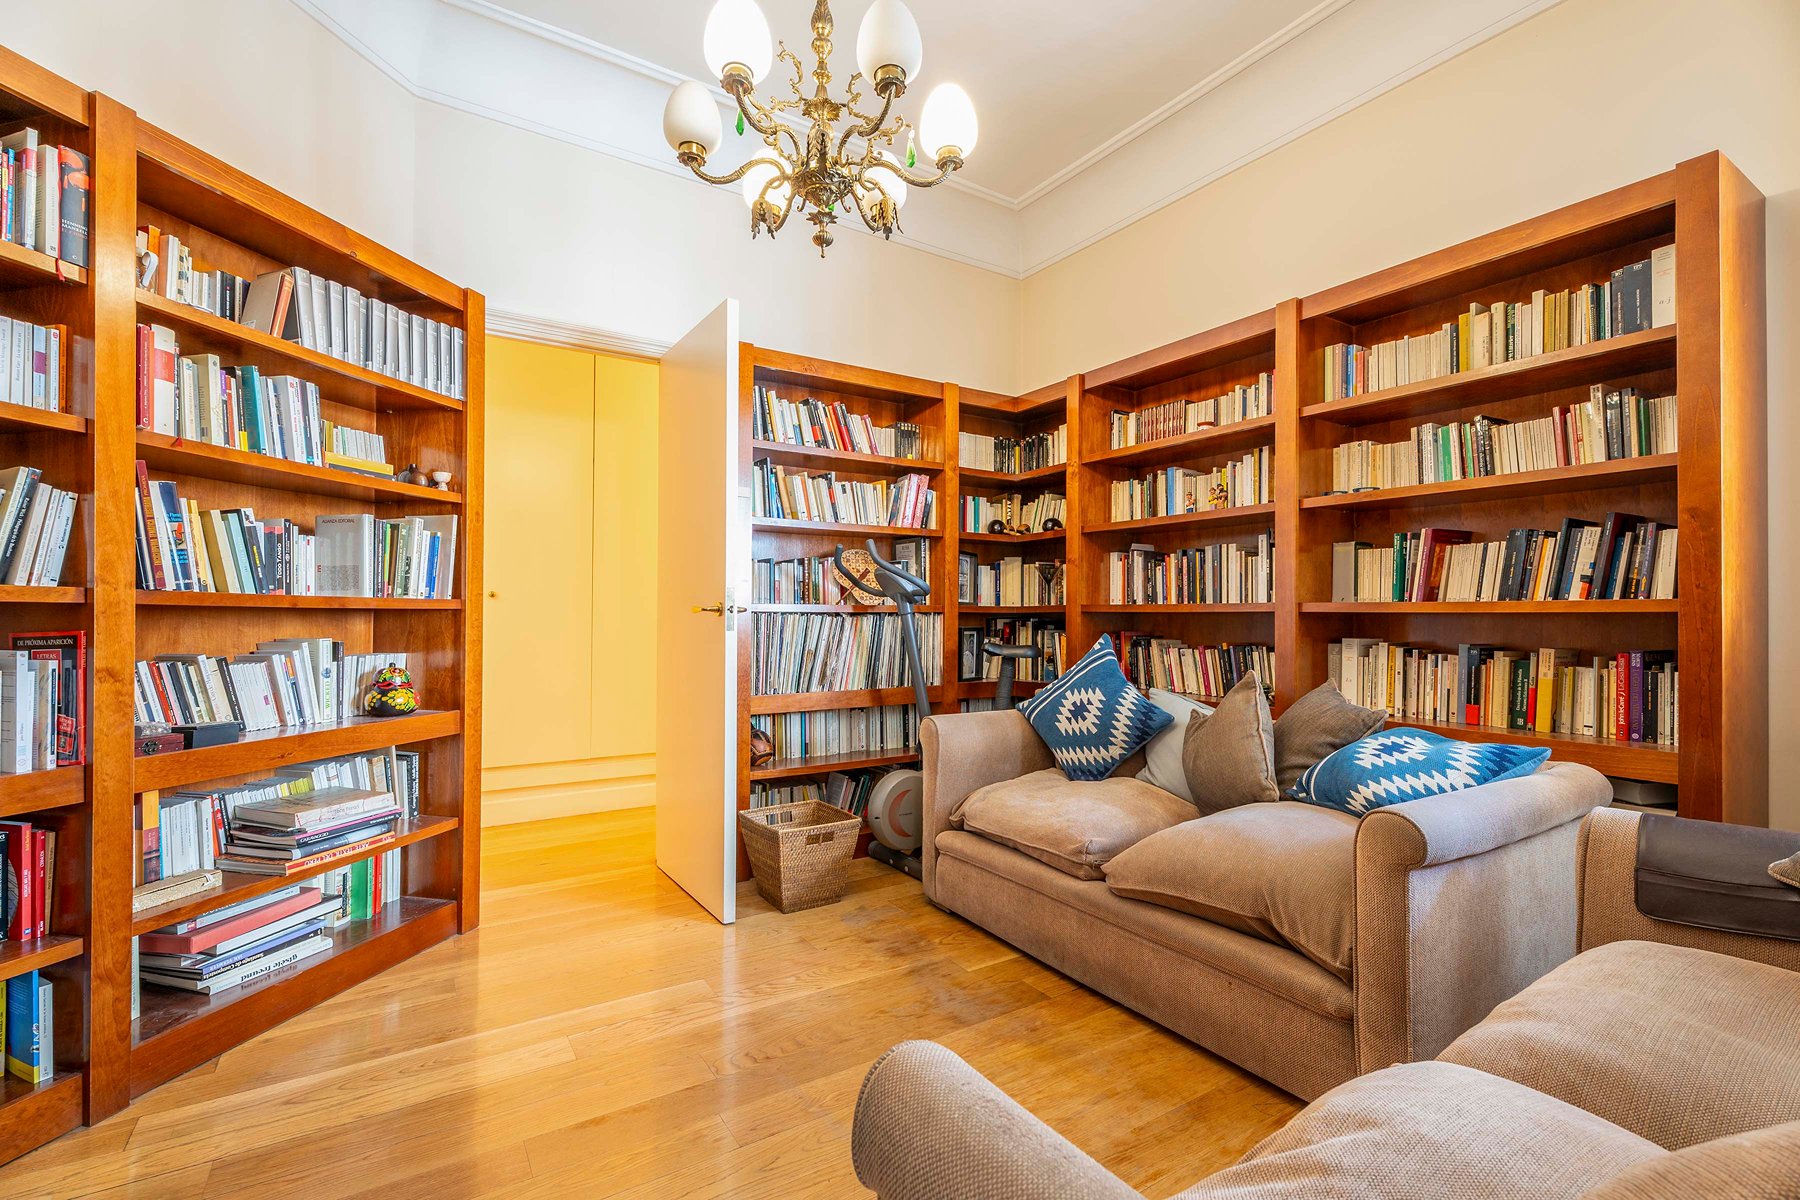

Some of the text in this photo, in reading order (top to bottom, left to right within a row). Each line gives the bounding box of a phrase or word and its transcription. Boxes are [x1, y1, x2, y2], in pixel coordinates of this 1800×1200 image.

[62, 218, 88, 230] HENNING
[62, 223, 88, 236] MANKELL
[143, 497, 154, 518] ILUSTRADA
[150, 538, 162, 566] ENCICLOPEDIA
[300, 832, 329, 843] CARAVAGGIO
[209, 958, 234, 971] VERMEER
[240, 964, 272, 981] freund
